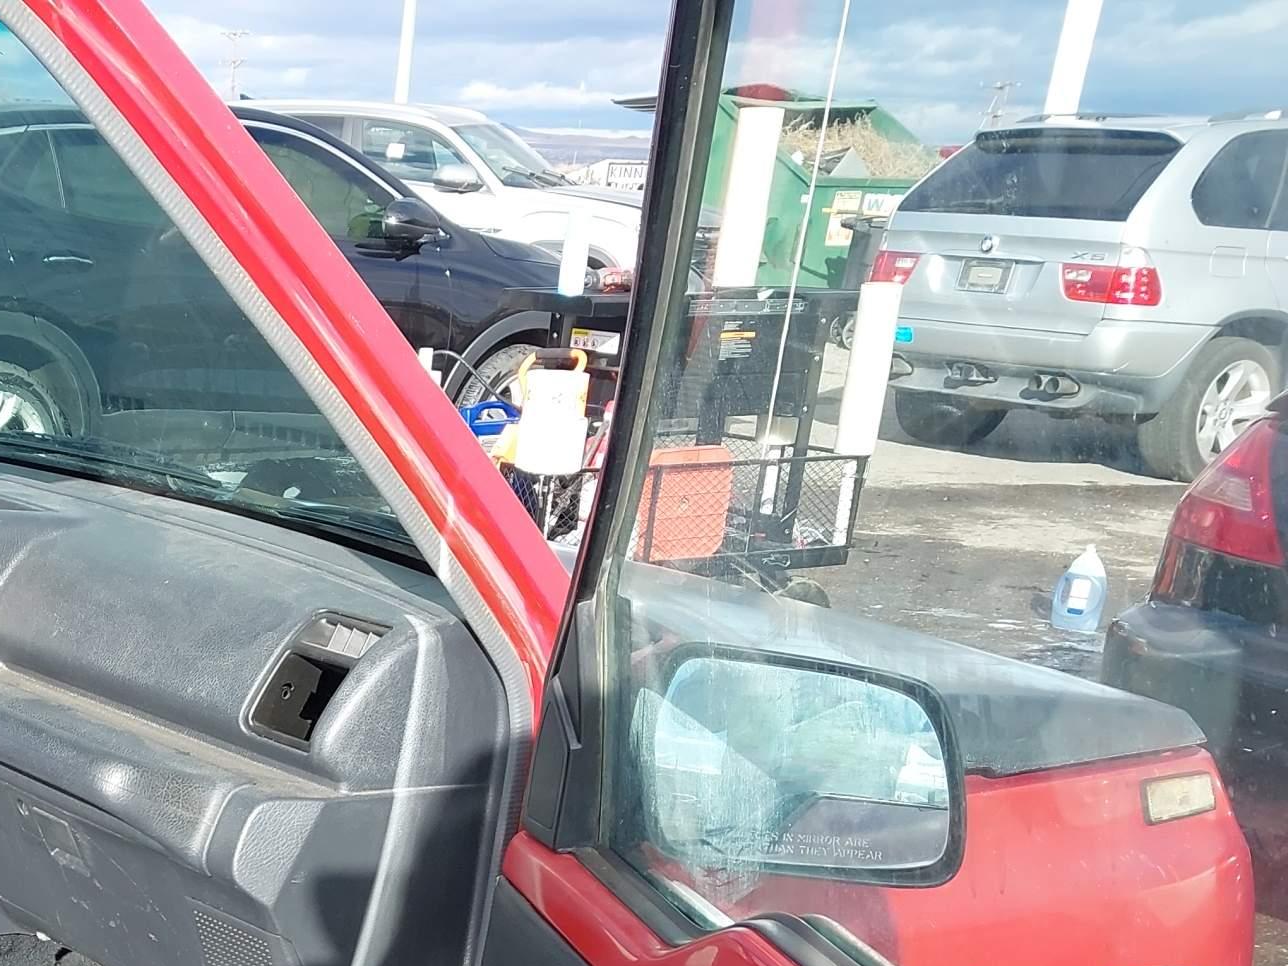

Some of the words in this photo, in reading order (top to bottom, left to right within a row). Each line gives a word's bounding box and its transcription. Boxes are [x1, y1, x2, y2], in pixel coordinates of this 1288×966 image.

[610, 166, 646, 179] KINN
[782, 832, 794, 843] IN
[797, 834, 841, 846] MIRROR
[844, 836, 872, 848] ARE
[799, 845, 829, 857] THEY
[833, 848, 883, 861] APPEAR
